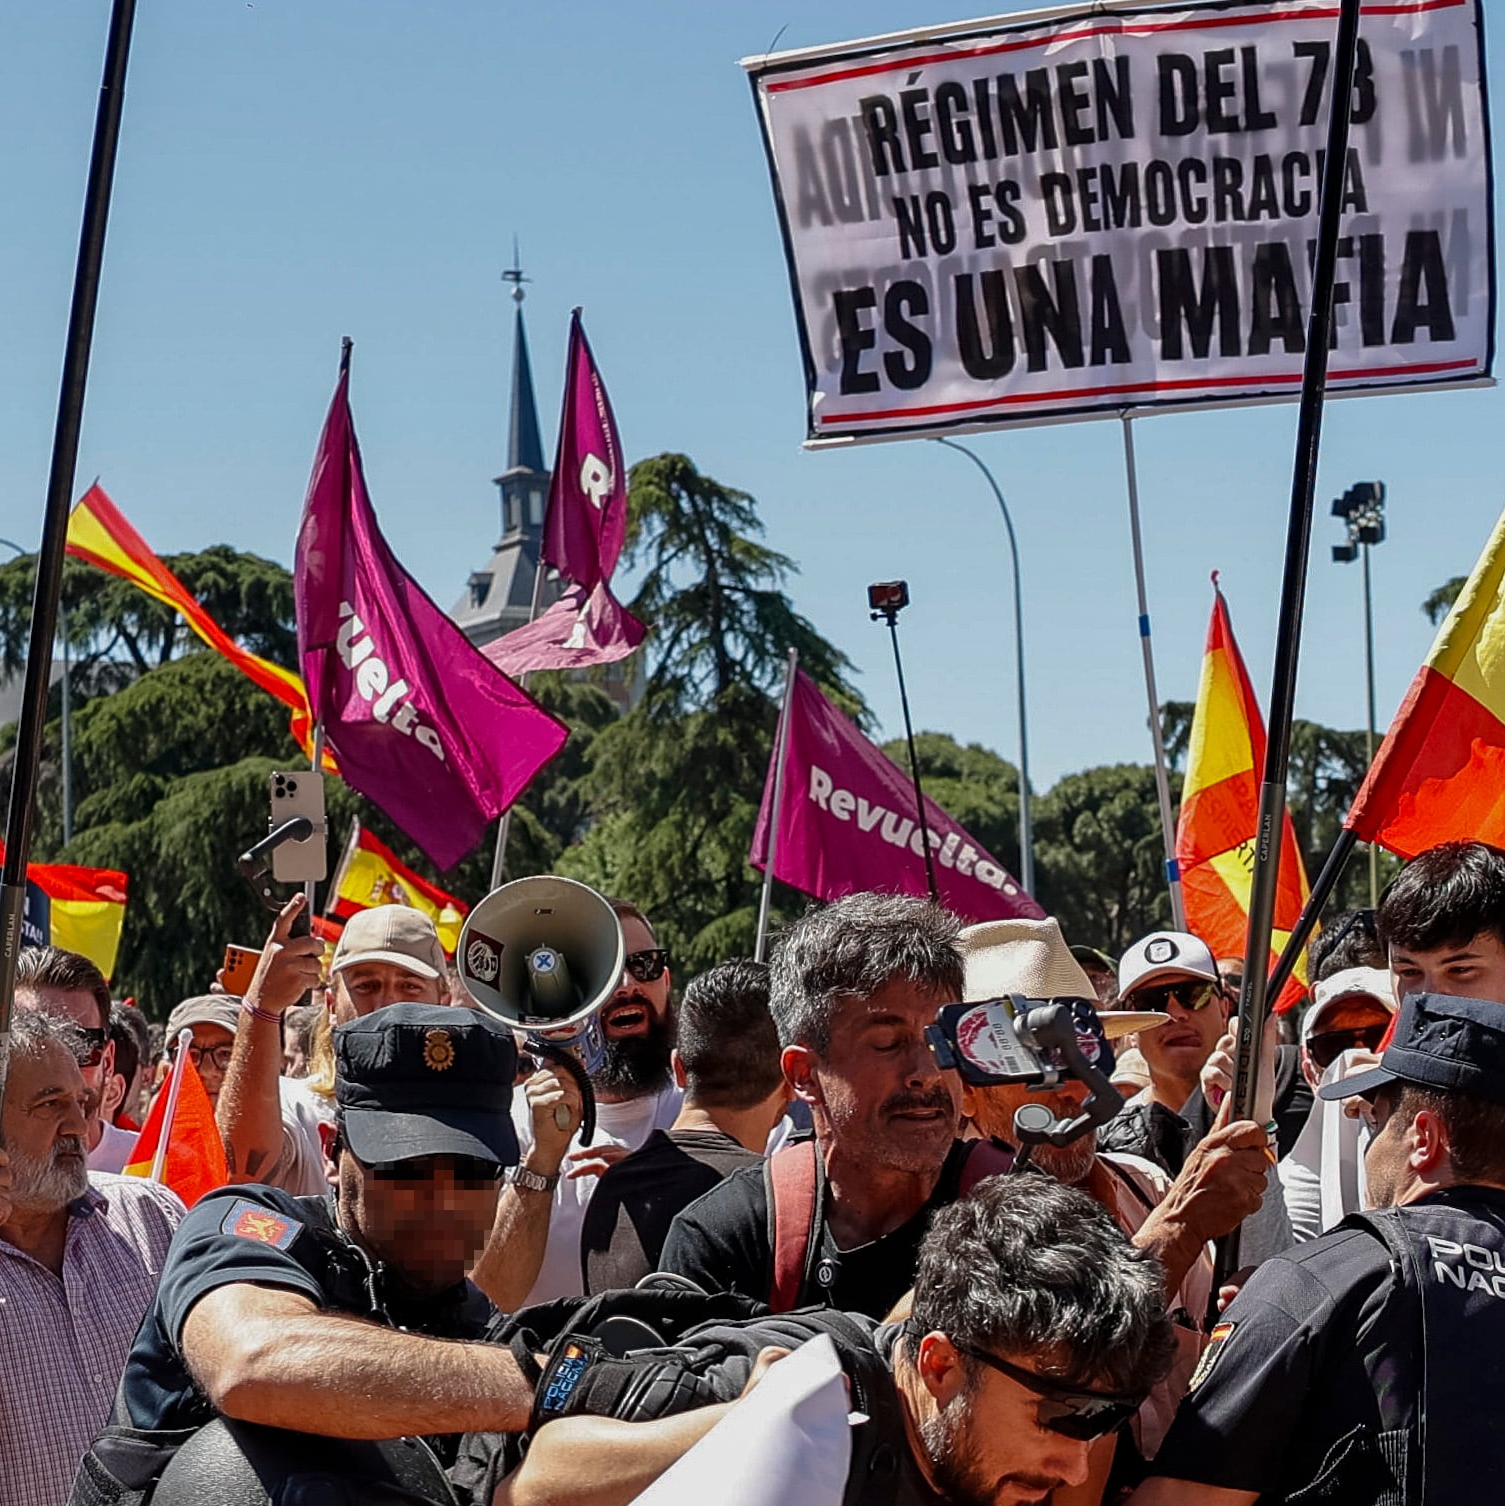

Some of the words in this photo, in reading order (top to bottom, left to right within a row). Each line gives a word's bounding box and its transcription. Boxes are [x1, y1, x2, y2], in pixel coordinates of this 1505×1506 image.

[860, 55, 1134, 176] RÉGIMEN
[1157, 46, 1277, 138] DEL
[895, 192, 955, 261] NO
[971, 180, 1026, 251] ES
[833, 280, 932, 397] ES
[955, 253, 1133, 382] UNA
[1158, 229, 1456, 362] MAFIA
[809, 765, 1018, 896] Revuelta.
[1260, 813, 1272, 862] CAPERLAN
